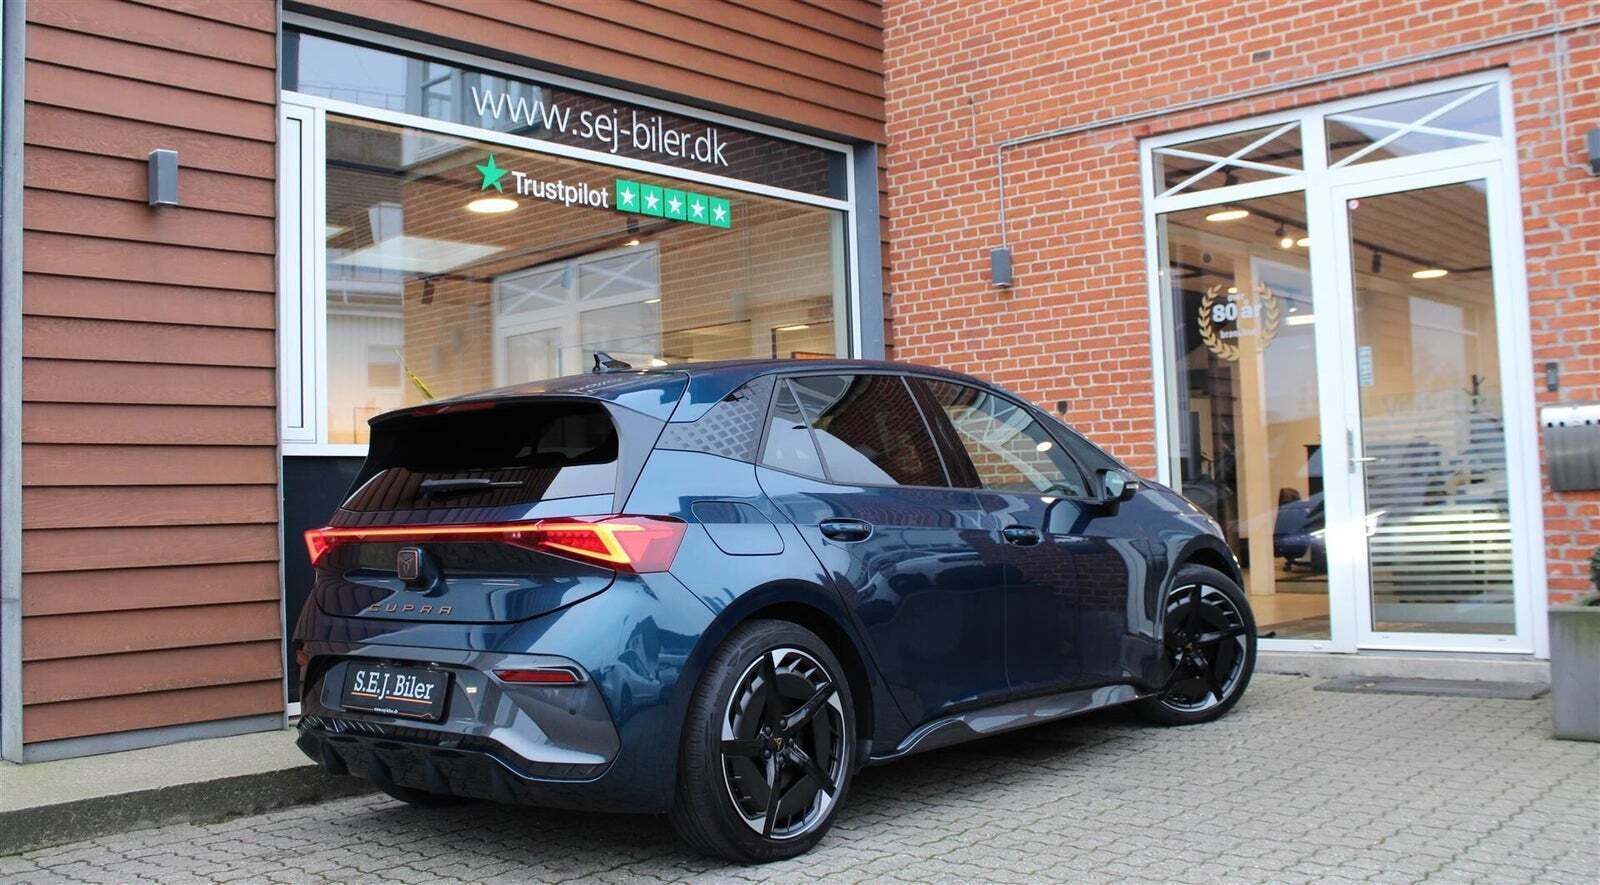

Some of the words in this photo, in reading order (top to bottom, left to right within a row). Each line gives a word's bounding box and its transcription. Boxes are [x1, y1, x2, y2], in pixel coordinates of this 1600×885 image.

[471, 86, 729, 167] www.sej-biler.dk
[511, 170, 610, 209] Trustpilot
[1212, 303, 1237, 323] 80
[367, 603, 453, 615] CUPRA
[353, 671, 390, 700] S.E.J.
[392, 674, 434, 700] Biler
